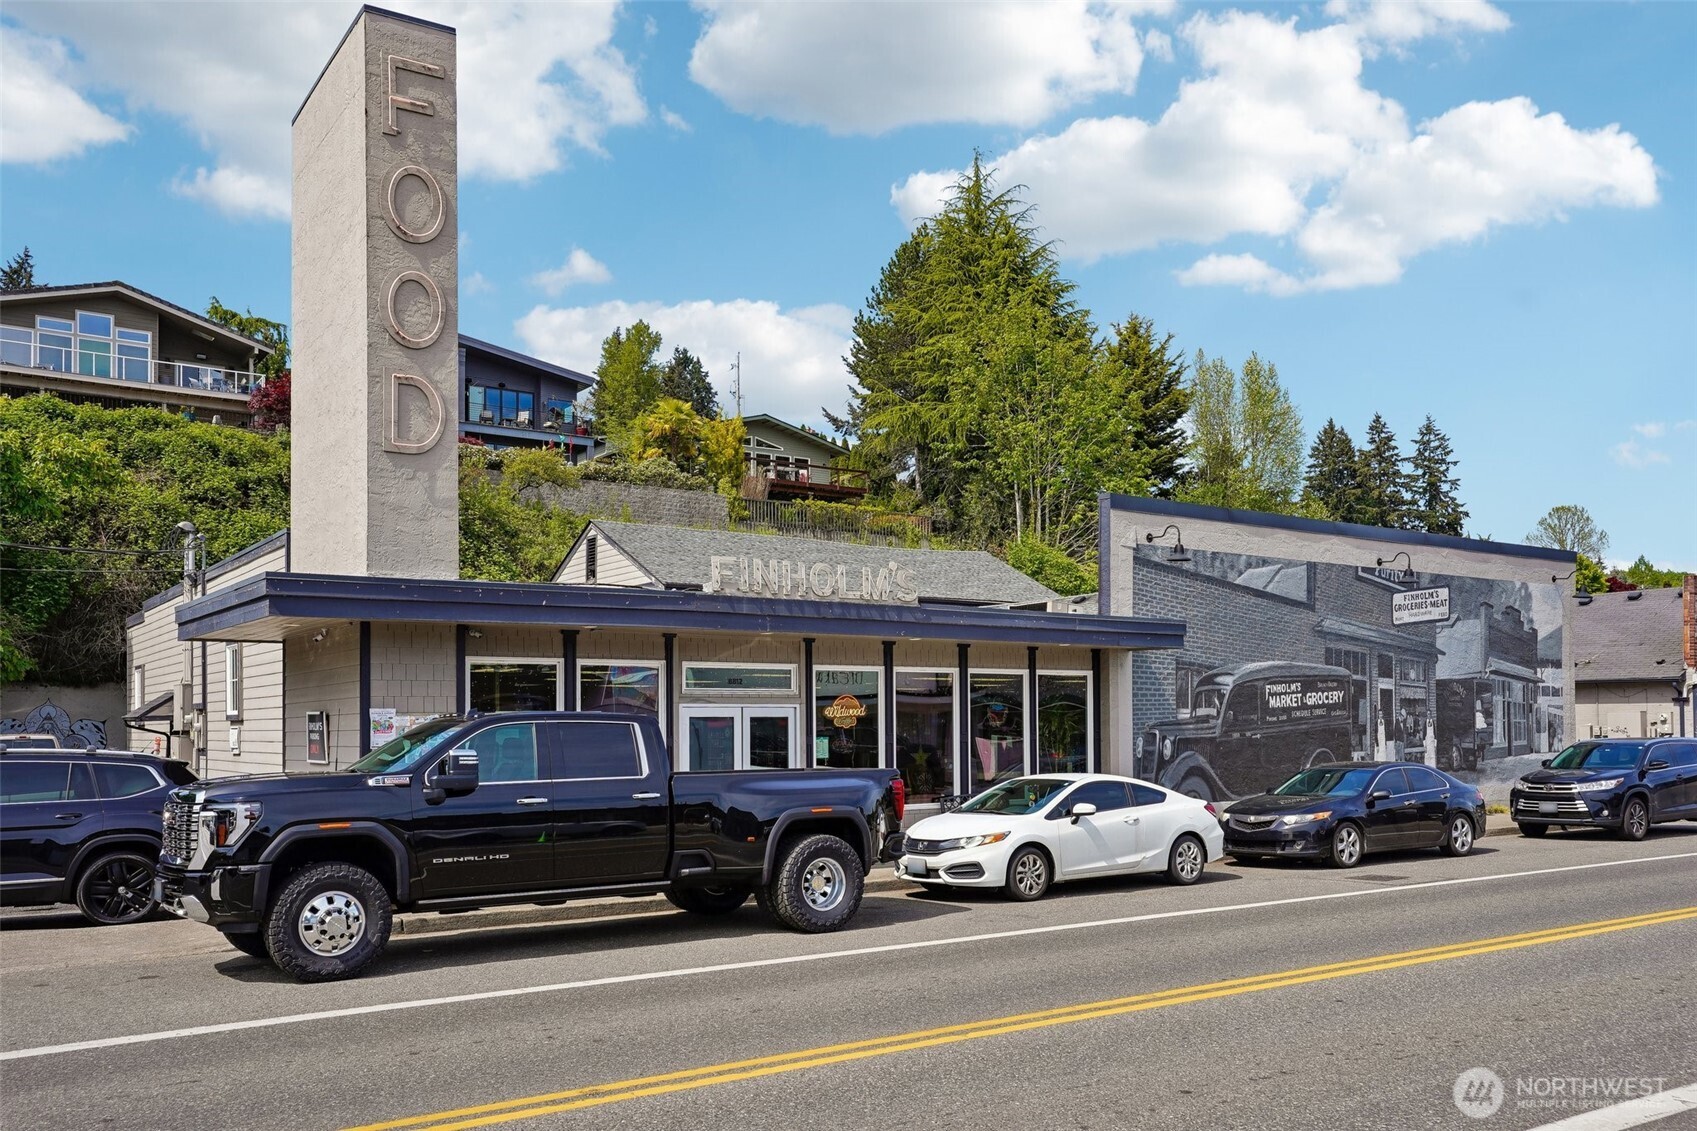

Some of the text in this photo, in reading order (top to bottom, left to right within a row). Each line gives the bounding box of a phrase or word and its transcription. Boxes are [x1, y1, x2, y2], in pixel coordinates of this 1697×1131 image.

[380, 47, 447, 455] FOOD
[711, 556, 919, 602] FINHOLM'S
[1403, 590, 1439, 602] FINHOLM'S
[1265, 682, 1301, 700] FINHOLM'S
[1269, 693, 1302, 708] MARKET
[1307, 690, 1344, 705] GROCERY
[824, 704, 866, 718] Wildwood
[433, 855, 487, 864] DENALI
